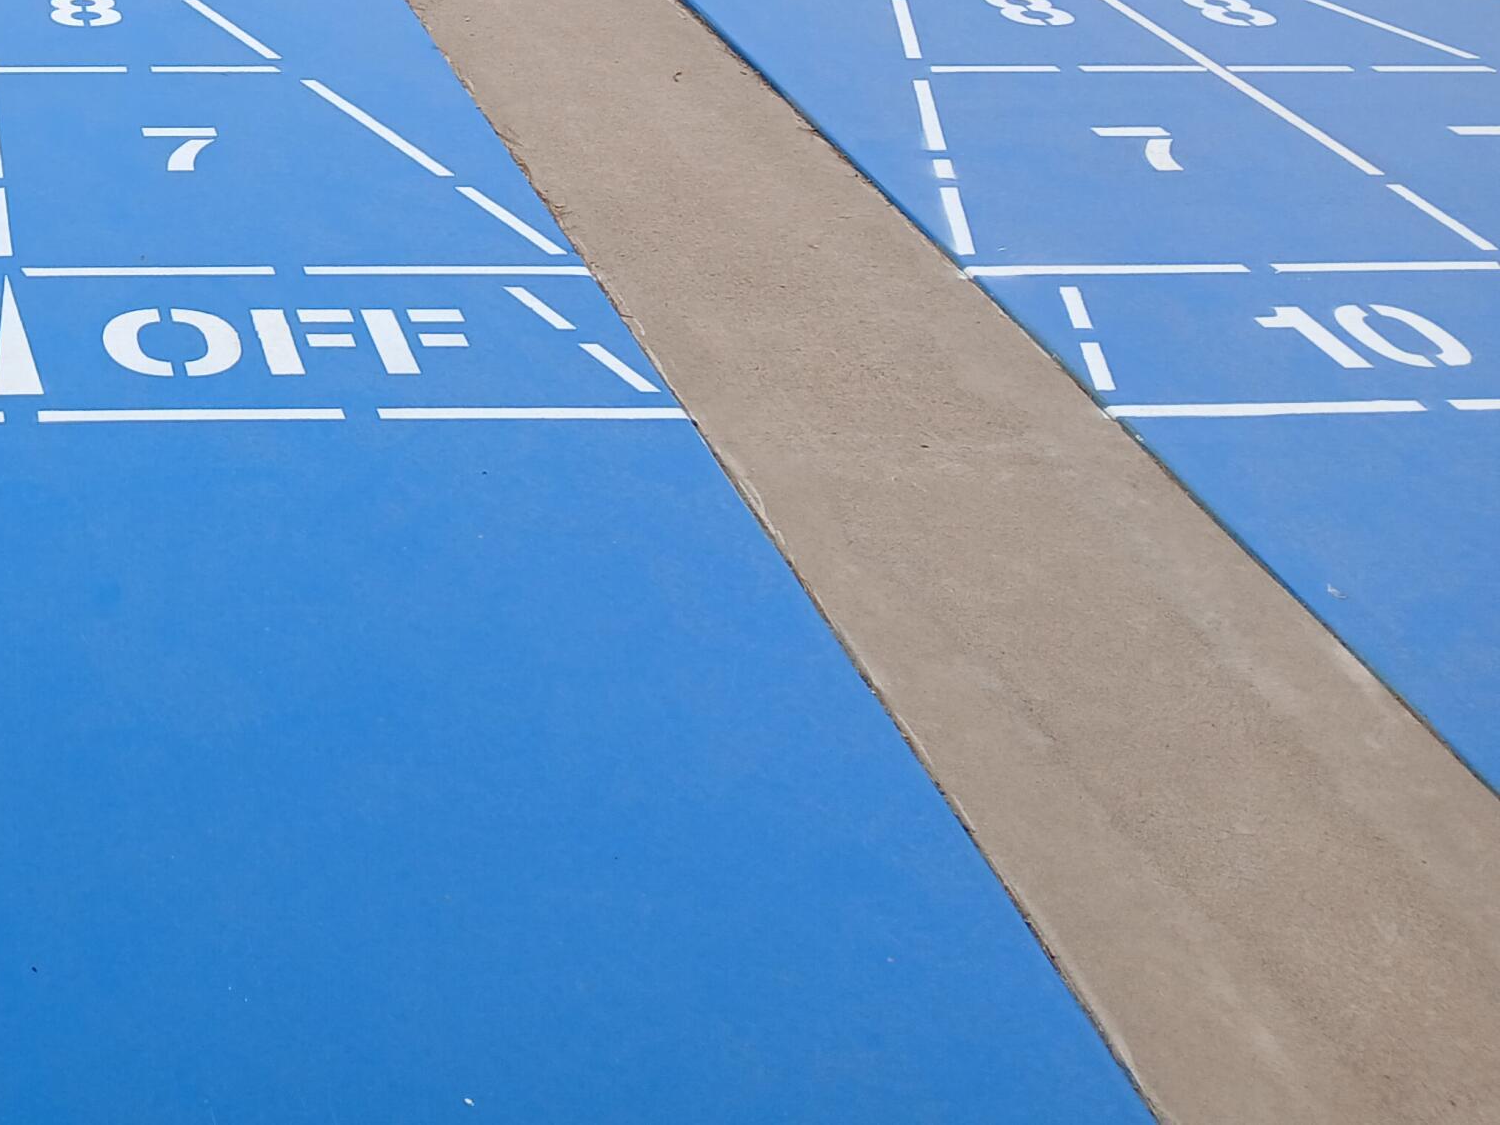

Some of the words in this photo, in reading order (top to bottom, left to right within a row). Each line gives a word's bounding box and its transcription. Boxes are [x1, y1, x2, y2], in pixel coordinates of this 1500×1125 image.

[141, 127, 217, 172] 7
[1090, 126, 1184, 172] 7
[102, 308, 470, 377] OFF
[1253, 304, 1473, 369] 10
